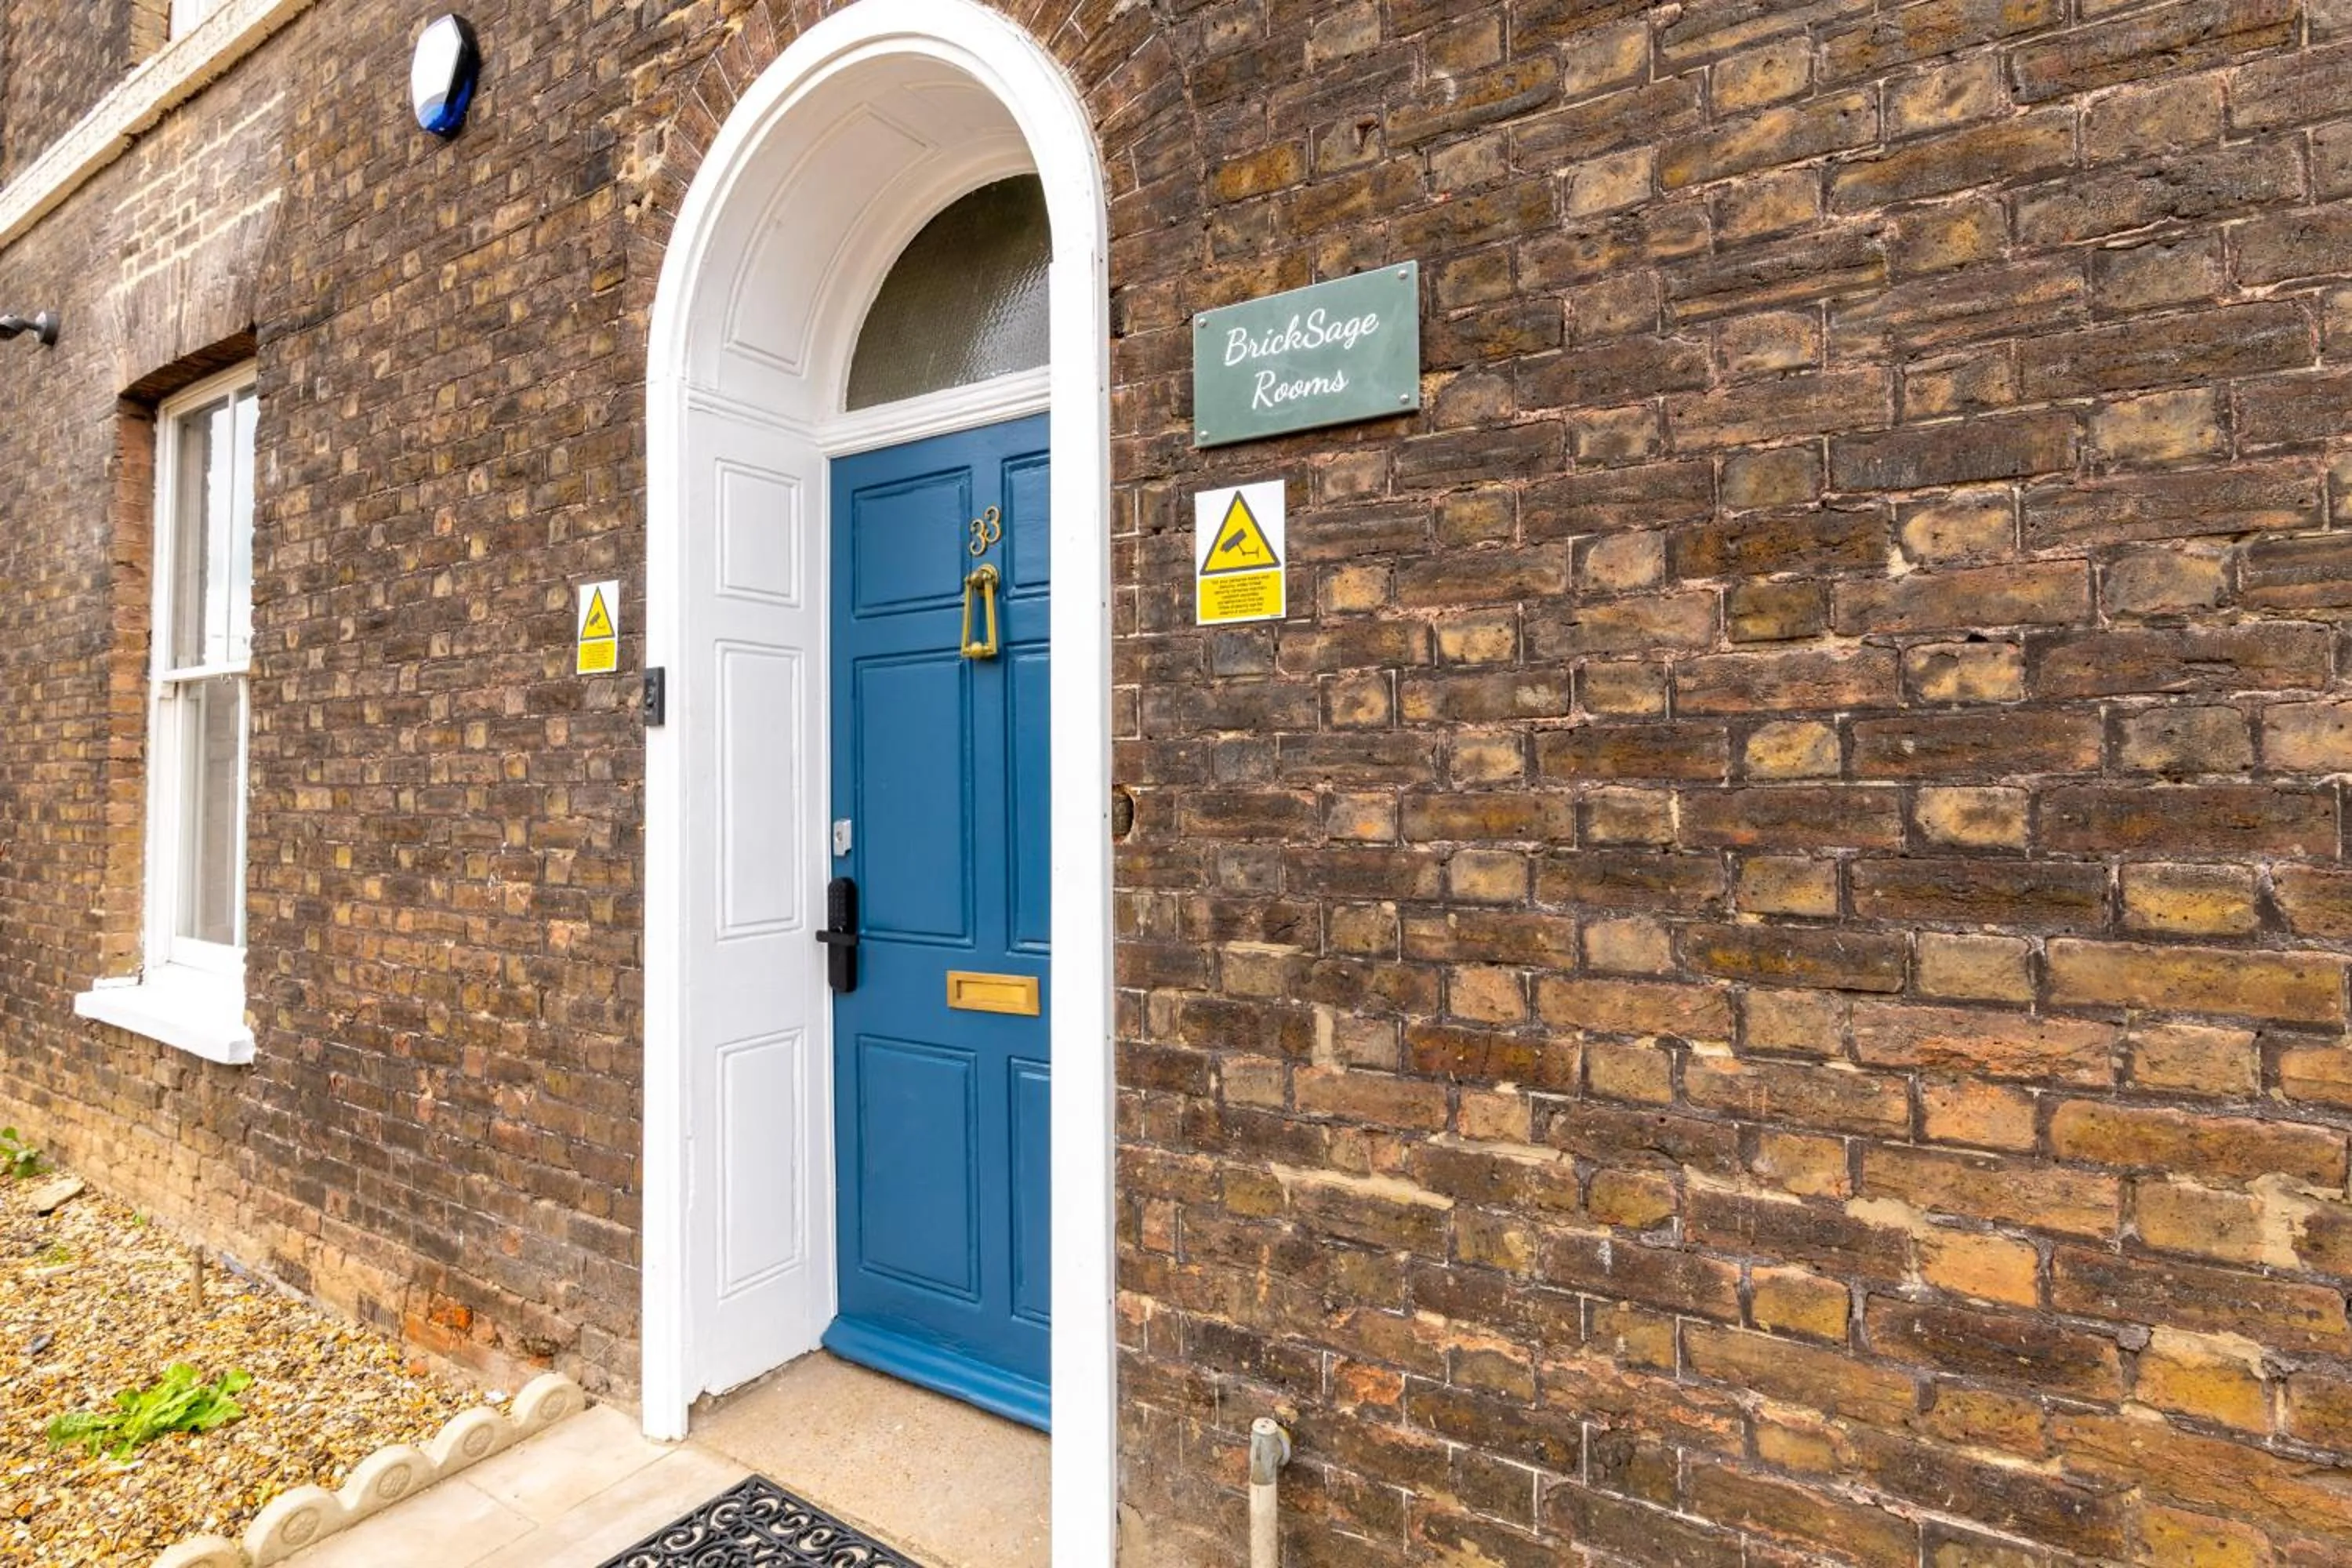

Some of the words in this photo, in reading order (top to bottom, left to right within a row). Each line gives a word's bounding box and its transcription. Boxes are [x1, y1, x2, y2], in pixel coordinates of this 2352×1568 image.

[1225, 308, 1379, 366] BrickSage
[1252, 369, 1348, 409] Rooms
[970, 506, 1001, 556] 33
